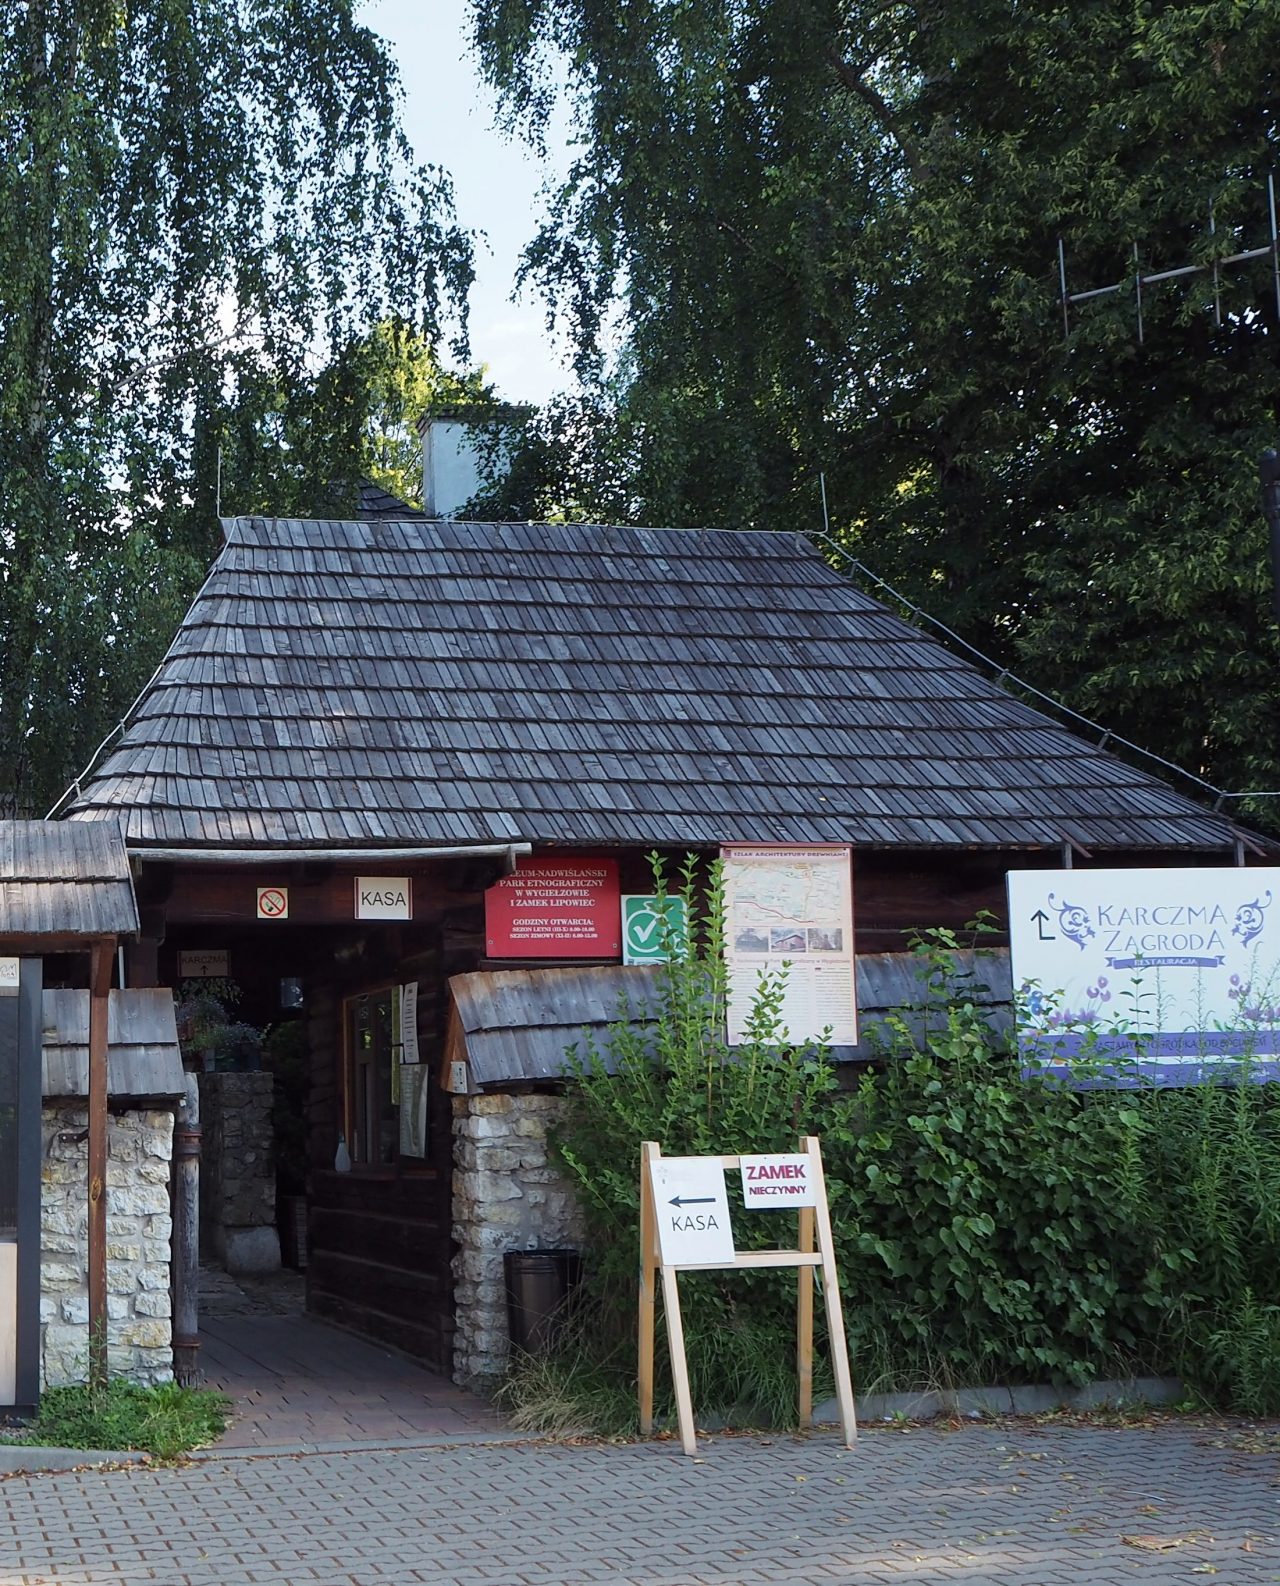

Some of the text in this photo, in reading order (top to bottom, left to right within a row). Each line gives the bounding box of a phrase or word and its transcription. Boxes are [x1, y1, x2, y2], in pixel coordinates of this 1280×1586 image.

[500, 879, 604, 887] PARK ETNOGRAFICZNY
[361, 891, 406, 906] KASA
[512, 918, 593, 926] GODZINY OTWARCIA:
[1097, 904, 1228, 926] KARCZMA
[1103, 929, 1225, 951] ZAGRODA
[181, 955, 226, 963] KARCZMA
[746, 1164, 807, 1180] ZAMEK
[749, 1185, 807, 1195] NIECZYNNY
[671, 1214, 719, 1231] KASA
